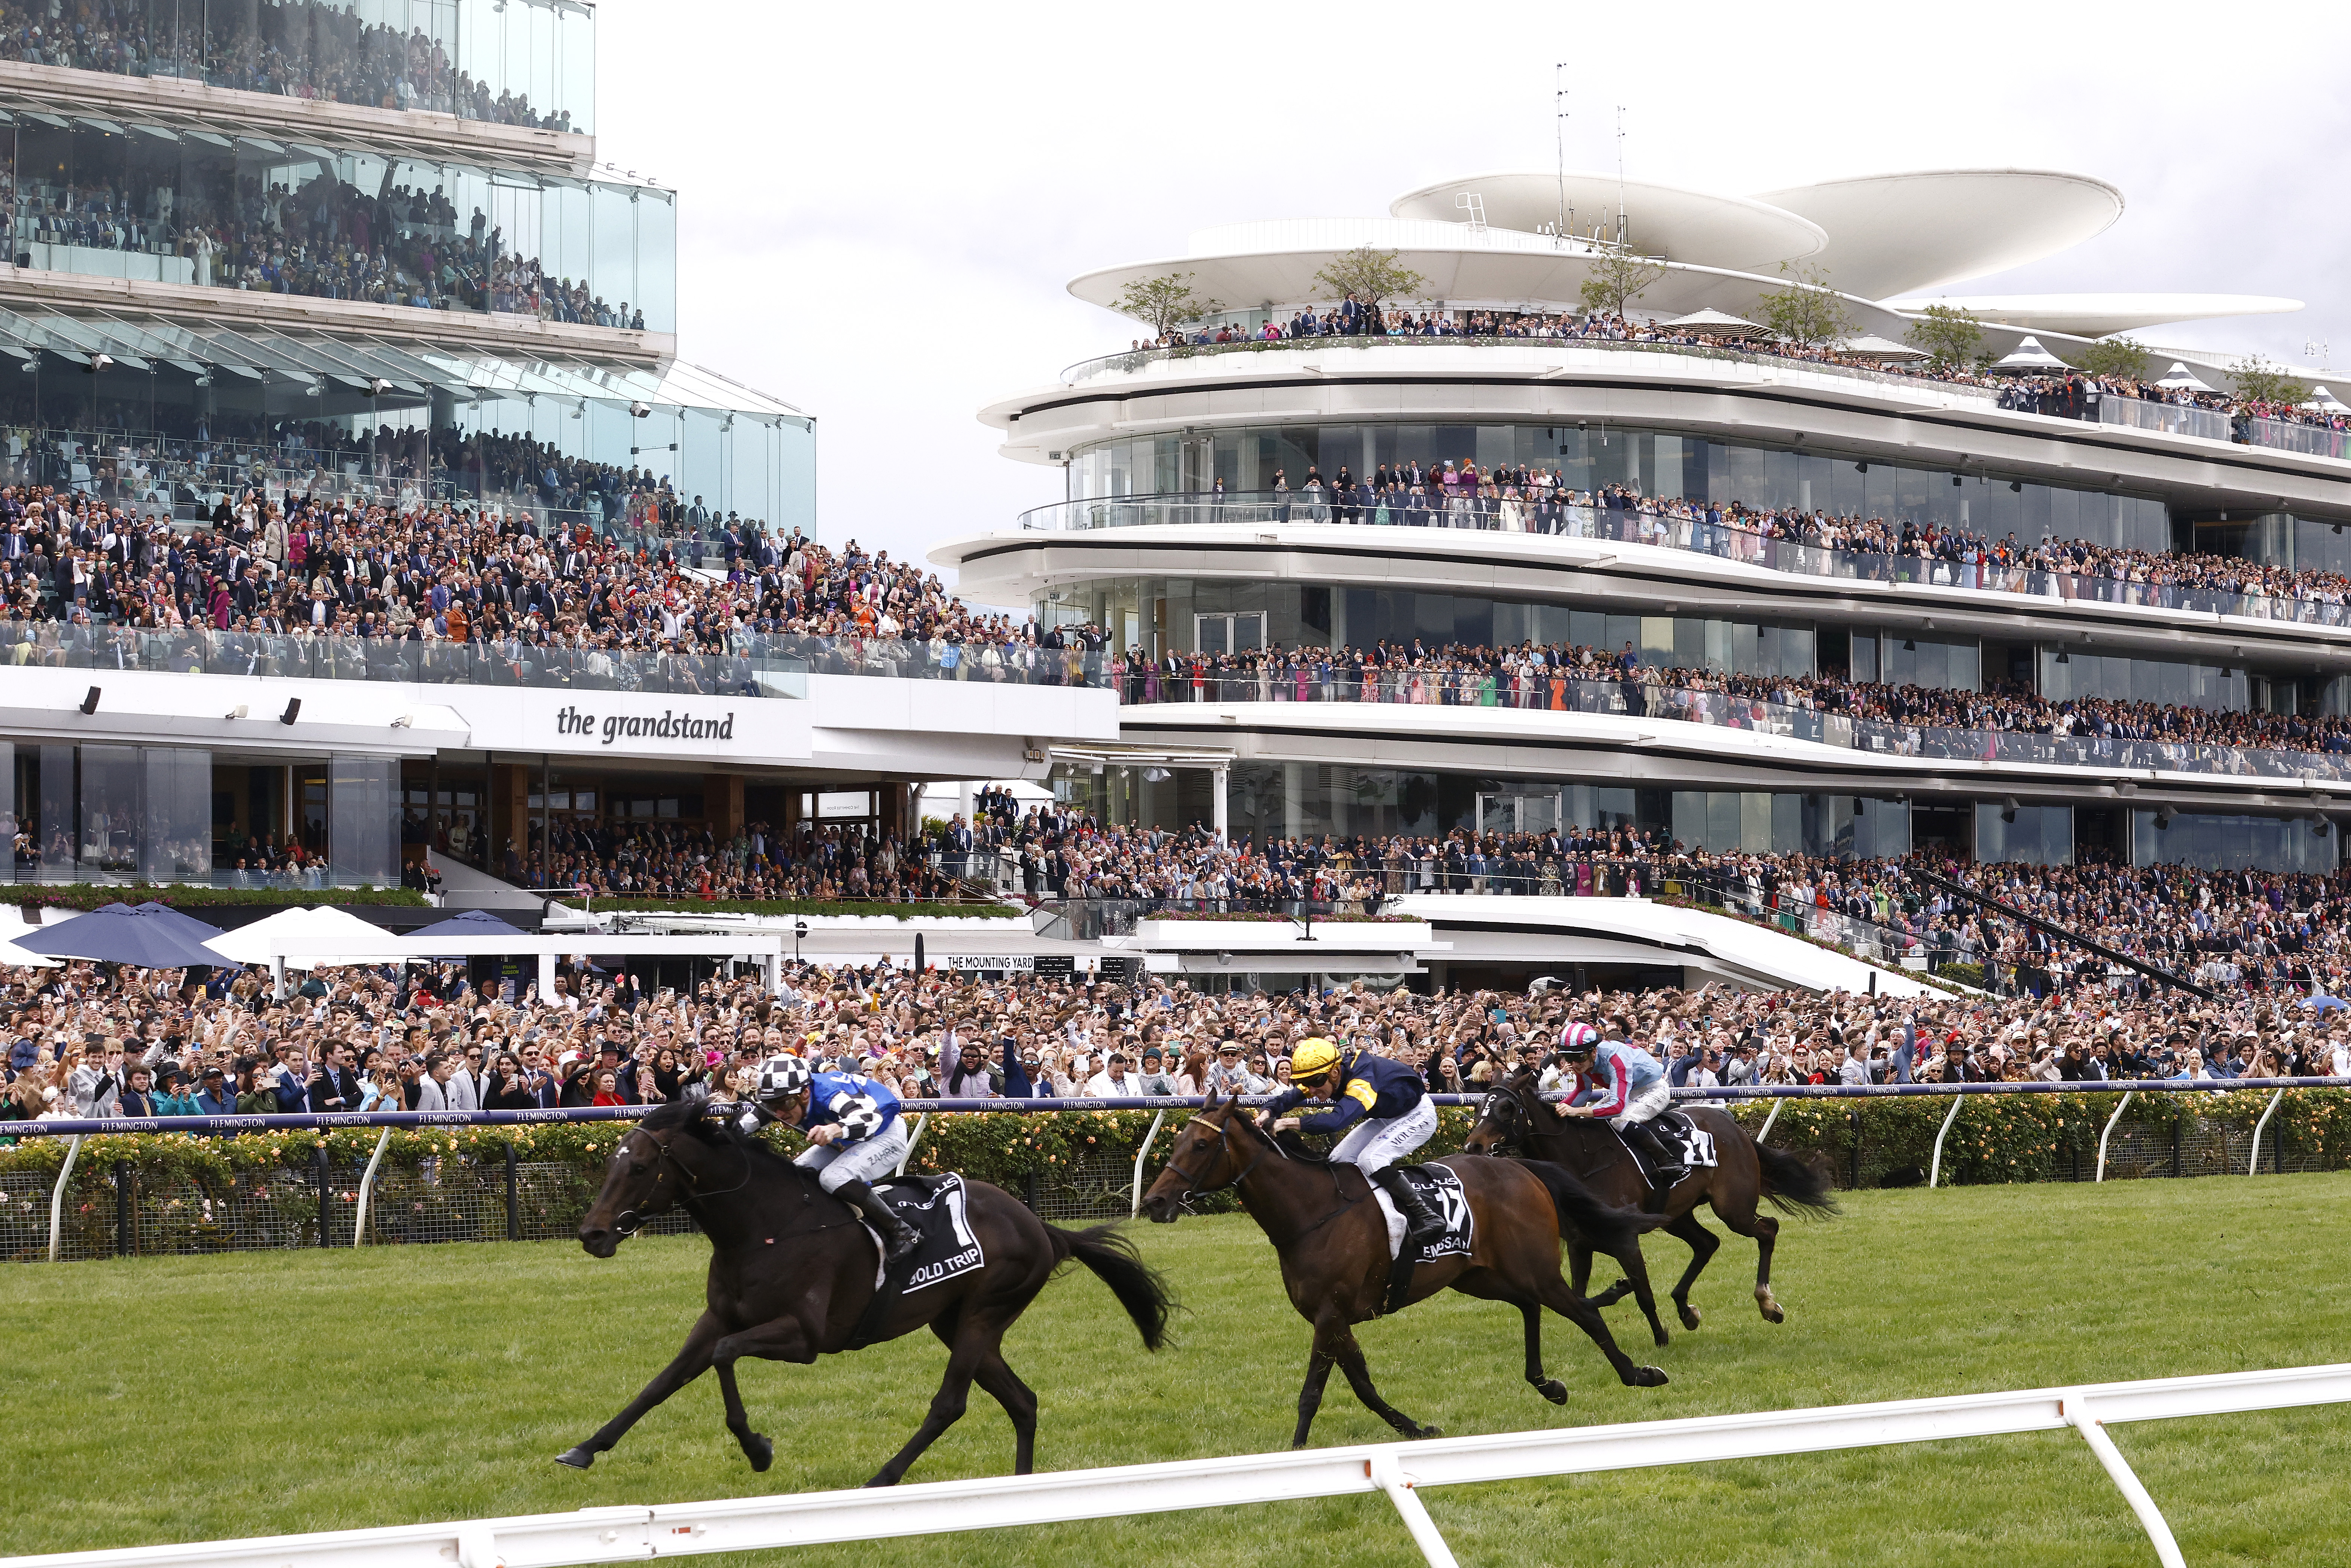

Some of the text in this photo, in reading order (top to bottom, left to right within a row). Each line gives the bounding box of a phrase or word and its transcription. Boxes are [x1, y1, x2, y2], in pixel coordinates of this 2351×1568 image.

[558, 706, 734, 744] the grandstand
[948, 957, 1033, 968] THE MOUNTING YARD
[980, 1101, 1024, 1110] FLEMINGTON
[1146, 1098, 1188, 1107] FLEMINGTON
[316, 1116, 370, 1125] FLEMINGTON
[419, 1114, 471, 1123] FLEMINGTON
[517, 1111, 568, 1121] FLEMINGTON
[101, 1121, 158, 1131] FLEMINGTON
[210, 1118, 265, 1128] FLEMINGTON
[1434, 1186, 1466, 1232] 17
[945, 1190, 973, 1247] 1
[944, 1248, 979, 1271] TRIP
